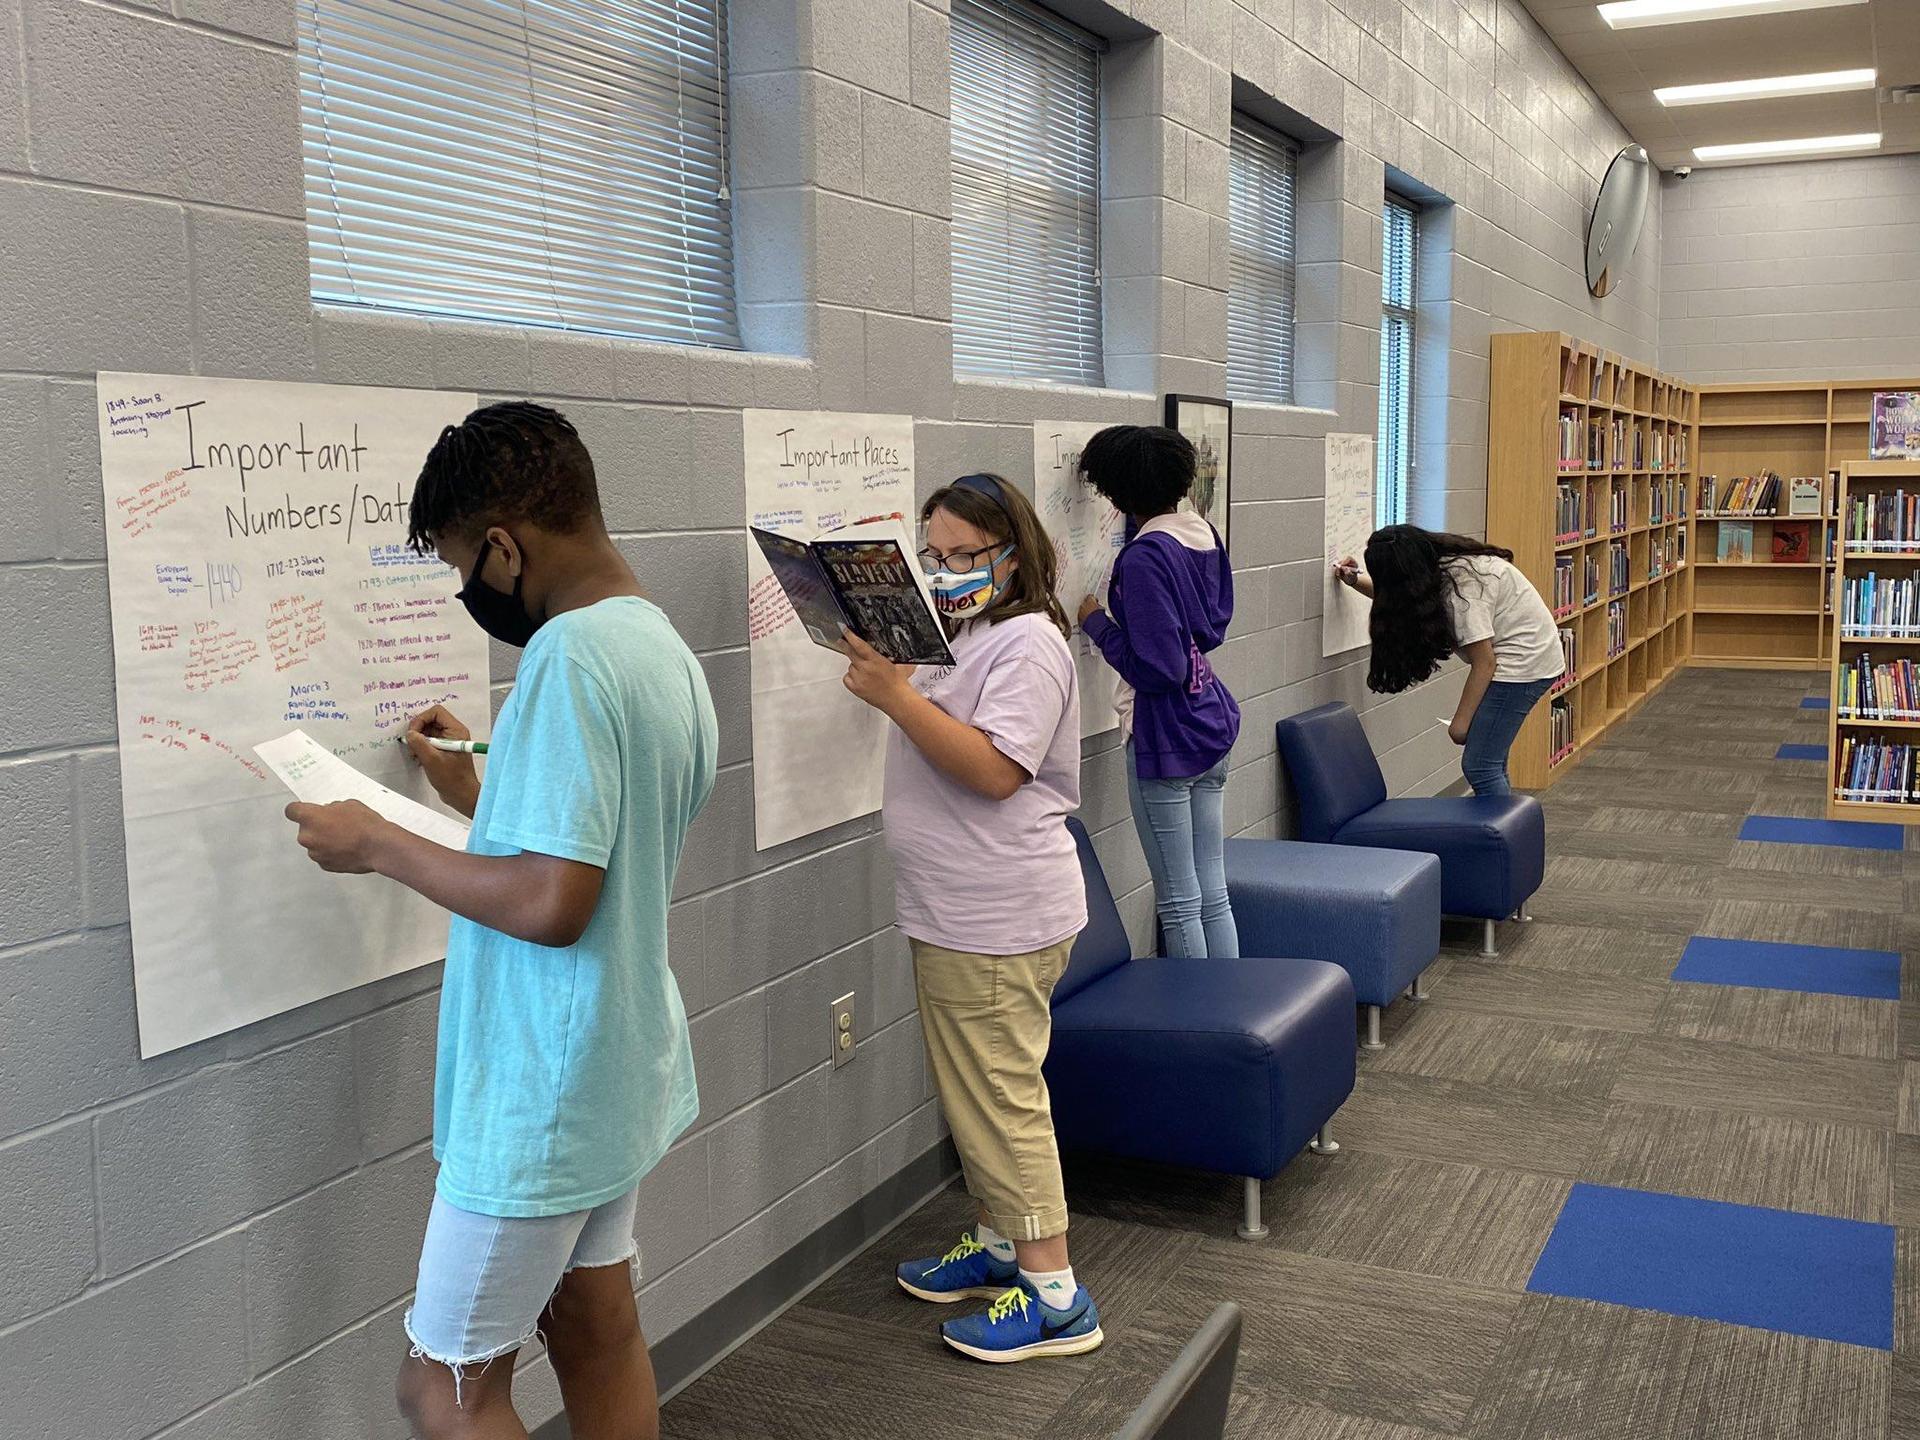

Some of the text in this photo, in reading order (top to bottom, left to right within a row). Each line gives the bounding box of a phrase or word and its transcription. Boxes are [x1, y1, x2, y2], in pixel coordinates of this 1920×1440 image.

[175, 400, 367, 492] Important
[776, 428, 860, 481] Important
[864, 436, 899, 467] Places
[1050, 434, 1081, 475] Impo
[226, 483, 413, 544] Numbers/Dat
[206, 561, 242, 607] 1440
[831, 560, 906, 584] SLAVERY
[290, 681, 330, 698] March 3
